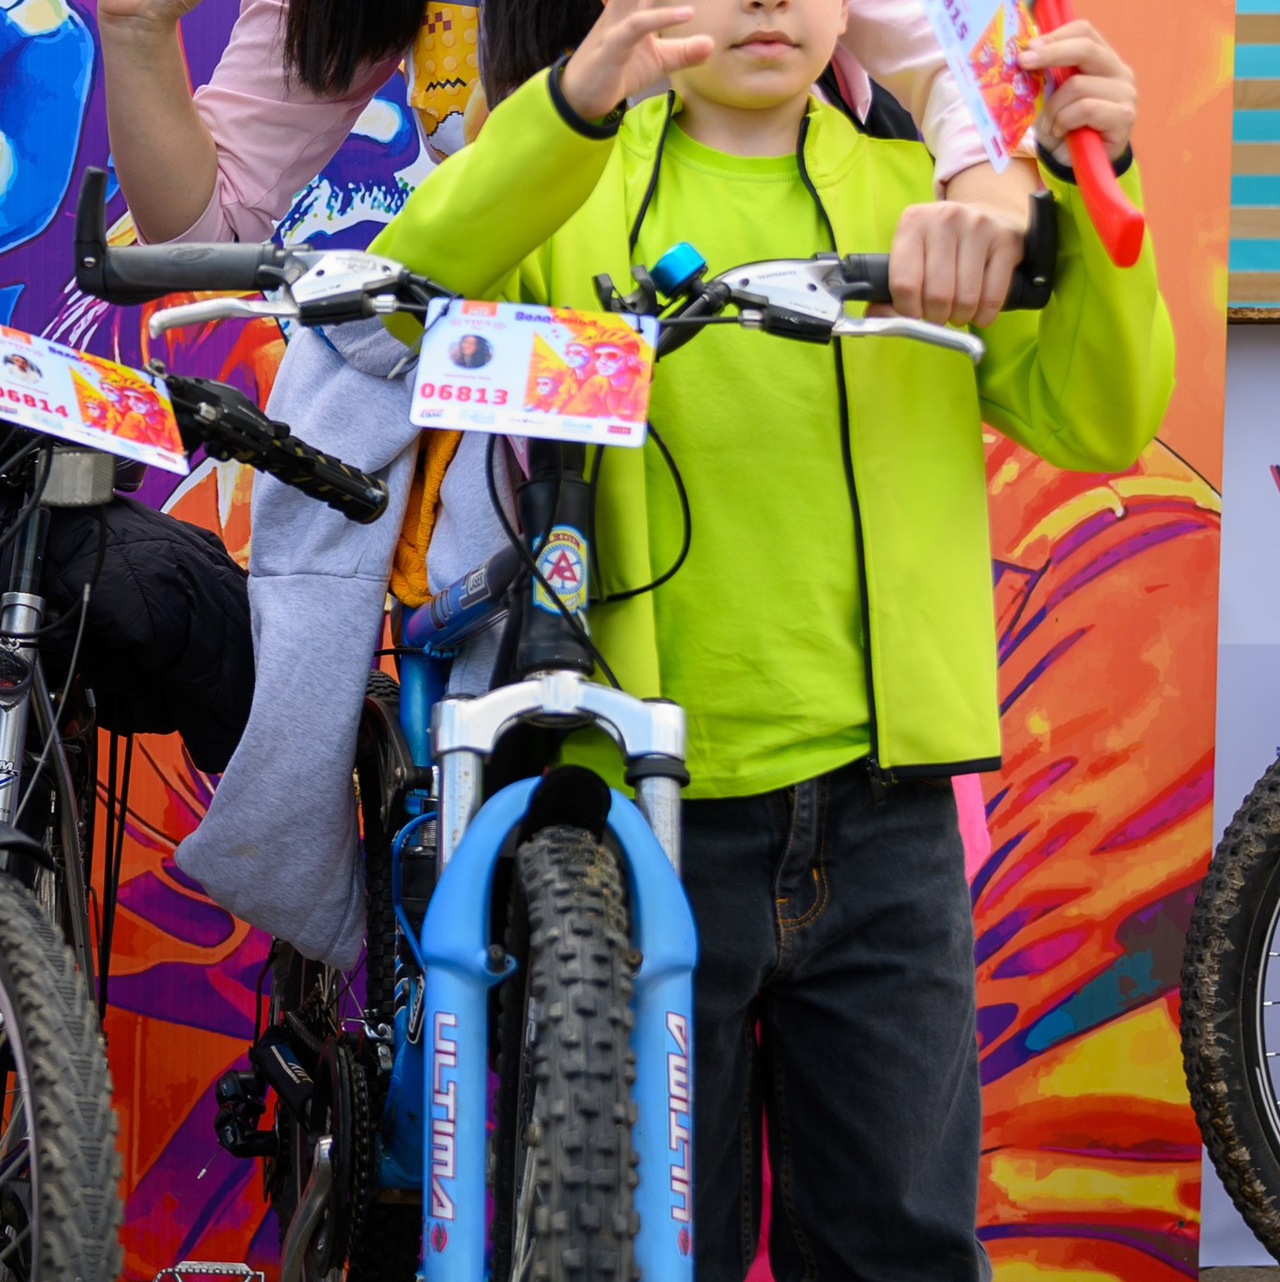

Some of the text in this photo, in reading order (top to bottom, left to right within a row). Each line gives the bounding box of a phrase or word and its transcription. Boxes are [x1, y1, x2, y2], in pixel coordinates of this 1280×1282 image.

[420, 383, 509, 406] 06813
[431, 1011, 457, 1221] ULTIMA
[666, 1011, 690, 1223] ULTIMA
